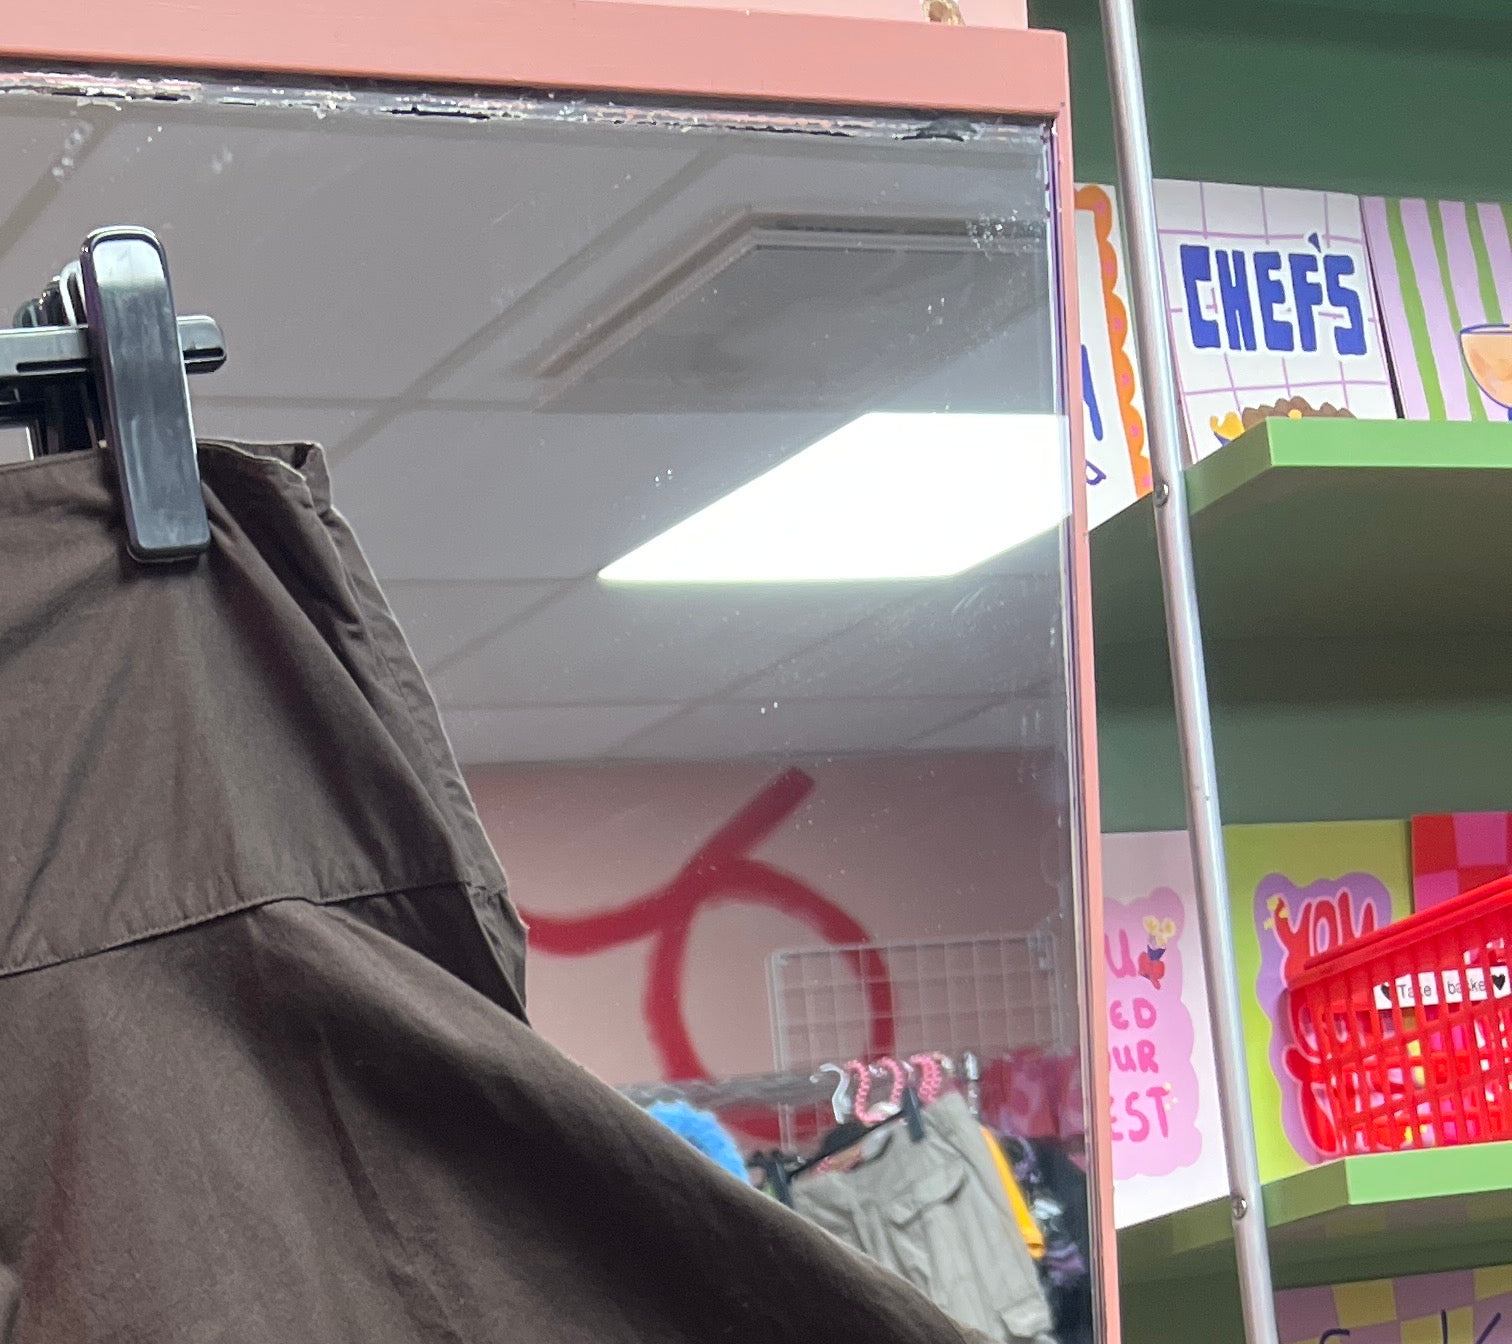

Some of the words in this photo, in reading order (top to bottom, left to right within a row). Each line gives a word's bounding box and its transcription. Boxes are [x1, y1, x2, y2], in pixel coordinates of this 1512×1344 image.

[1179, 232, 1367, 355] CHEF'S
[1397, 983, 1432, 998] Tae
[1447, 978, 1487, 994] bake
[1109, 997, 1157, 1030] ED
[1108, 1039, 1159, 1074] UR
[1111, 1087, 1170, 1142] EST
